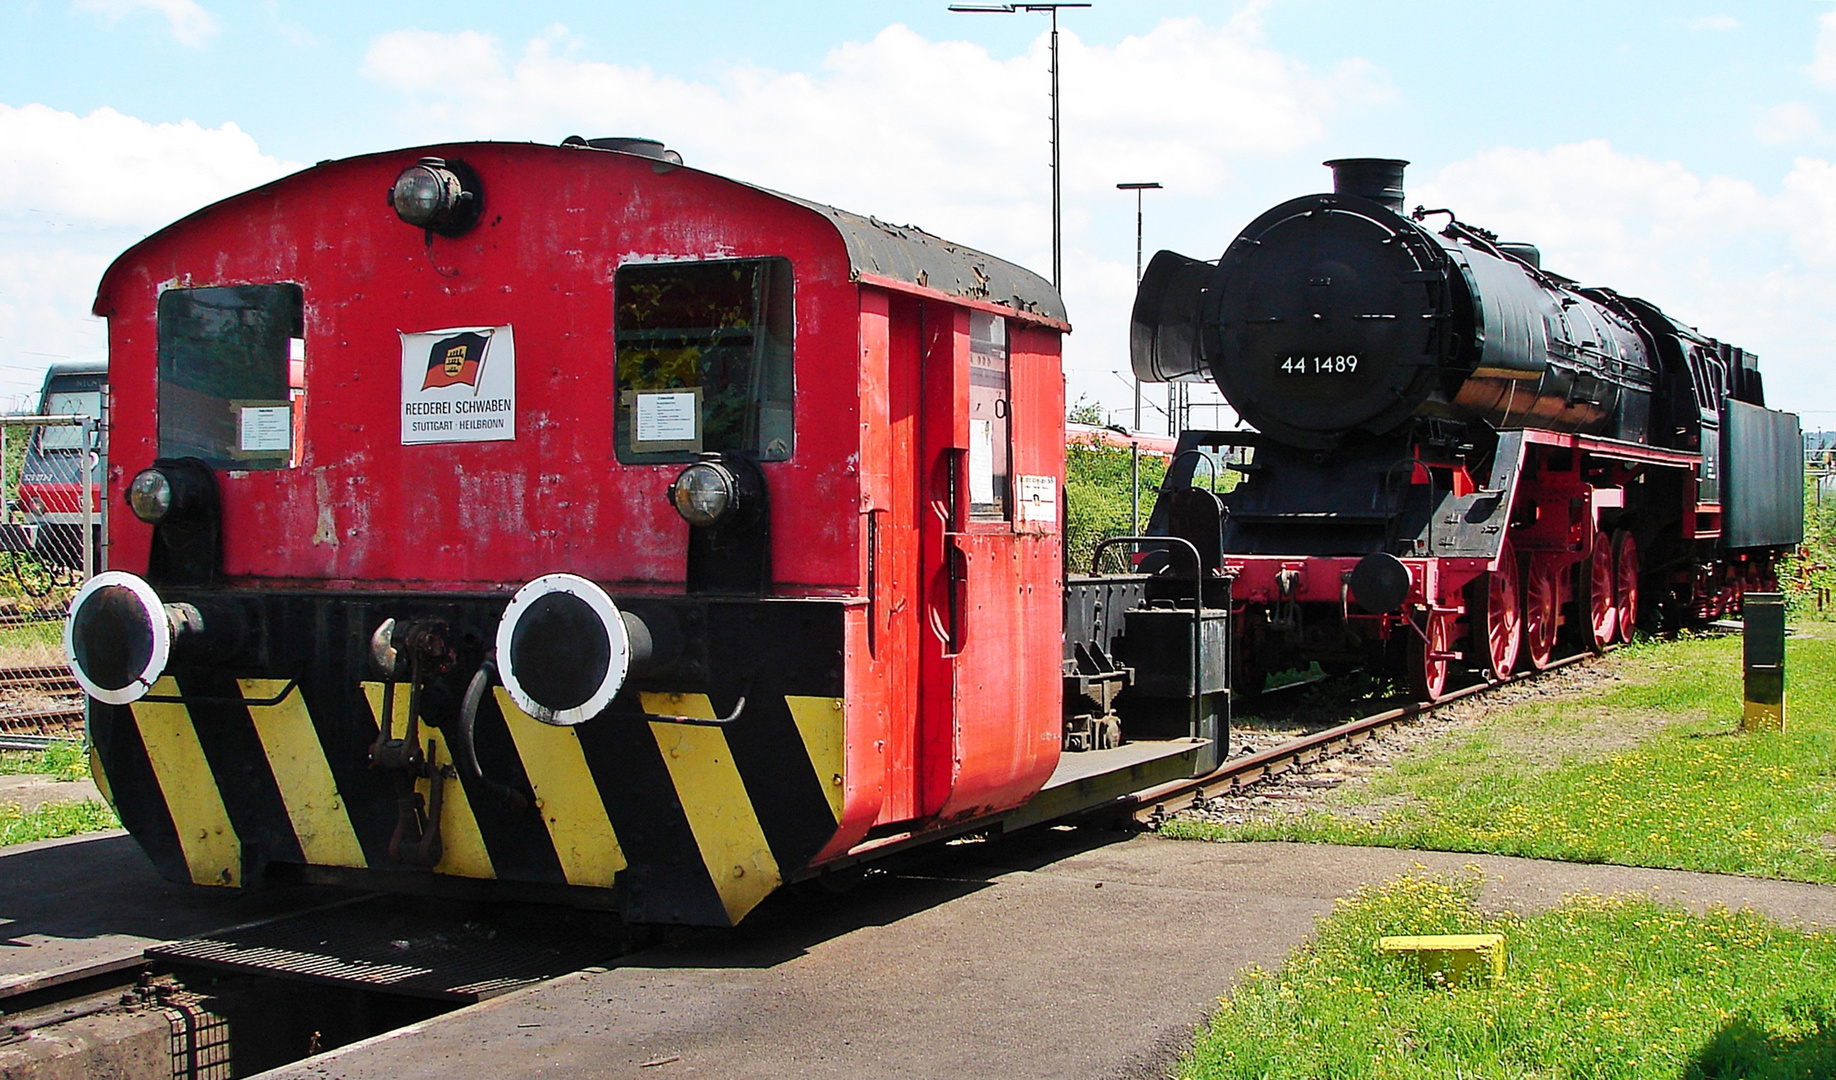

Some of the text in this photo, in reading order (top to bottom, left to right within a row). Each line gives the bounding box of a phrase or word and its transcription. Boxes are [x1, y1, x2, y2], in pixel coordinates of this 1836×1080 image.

[1281, 355, 1358, 373] 44 1489
[405, 399, 511, 415] REEDEREI SCHWABEN
[412, 418, 504, 432] STUTTGART HEILBRONN
